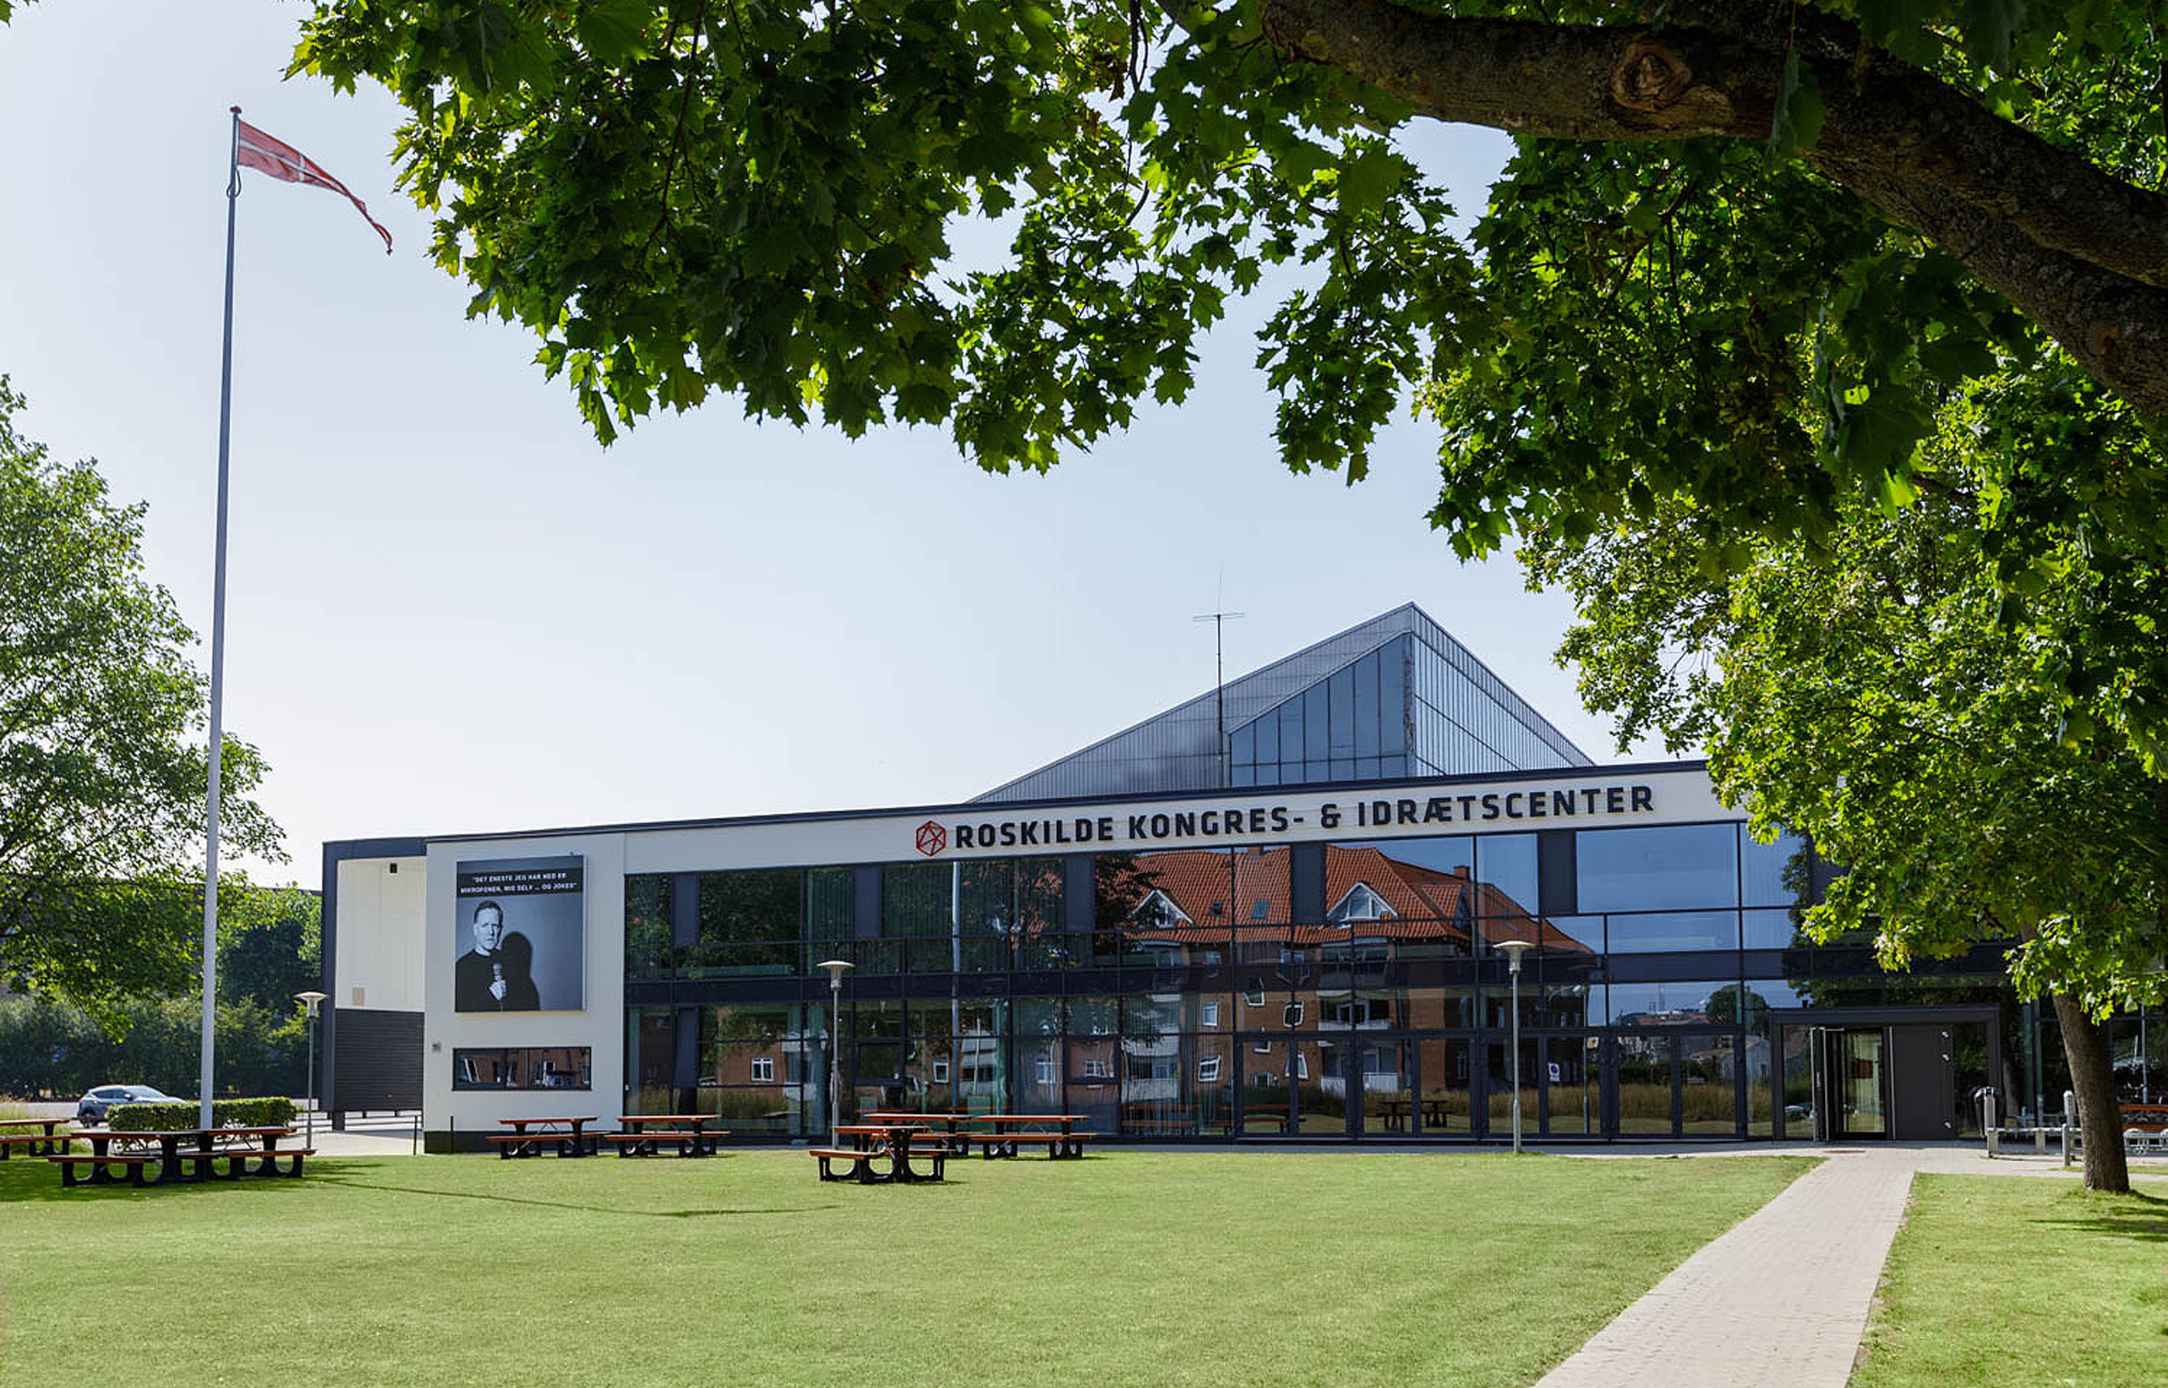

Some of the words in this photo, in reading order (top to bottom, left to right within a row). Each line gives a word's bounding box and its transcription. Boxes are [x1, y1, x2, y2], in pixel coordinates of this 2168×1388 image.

[955, 817, 1114, 849] ROSKILDE
[1129, 806, 1304, 840] KONGRES-
[1320, 803, 1342, 829] &
[1358, 785, 1655, 827] IDRÆTSCENTER
